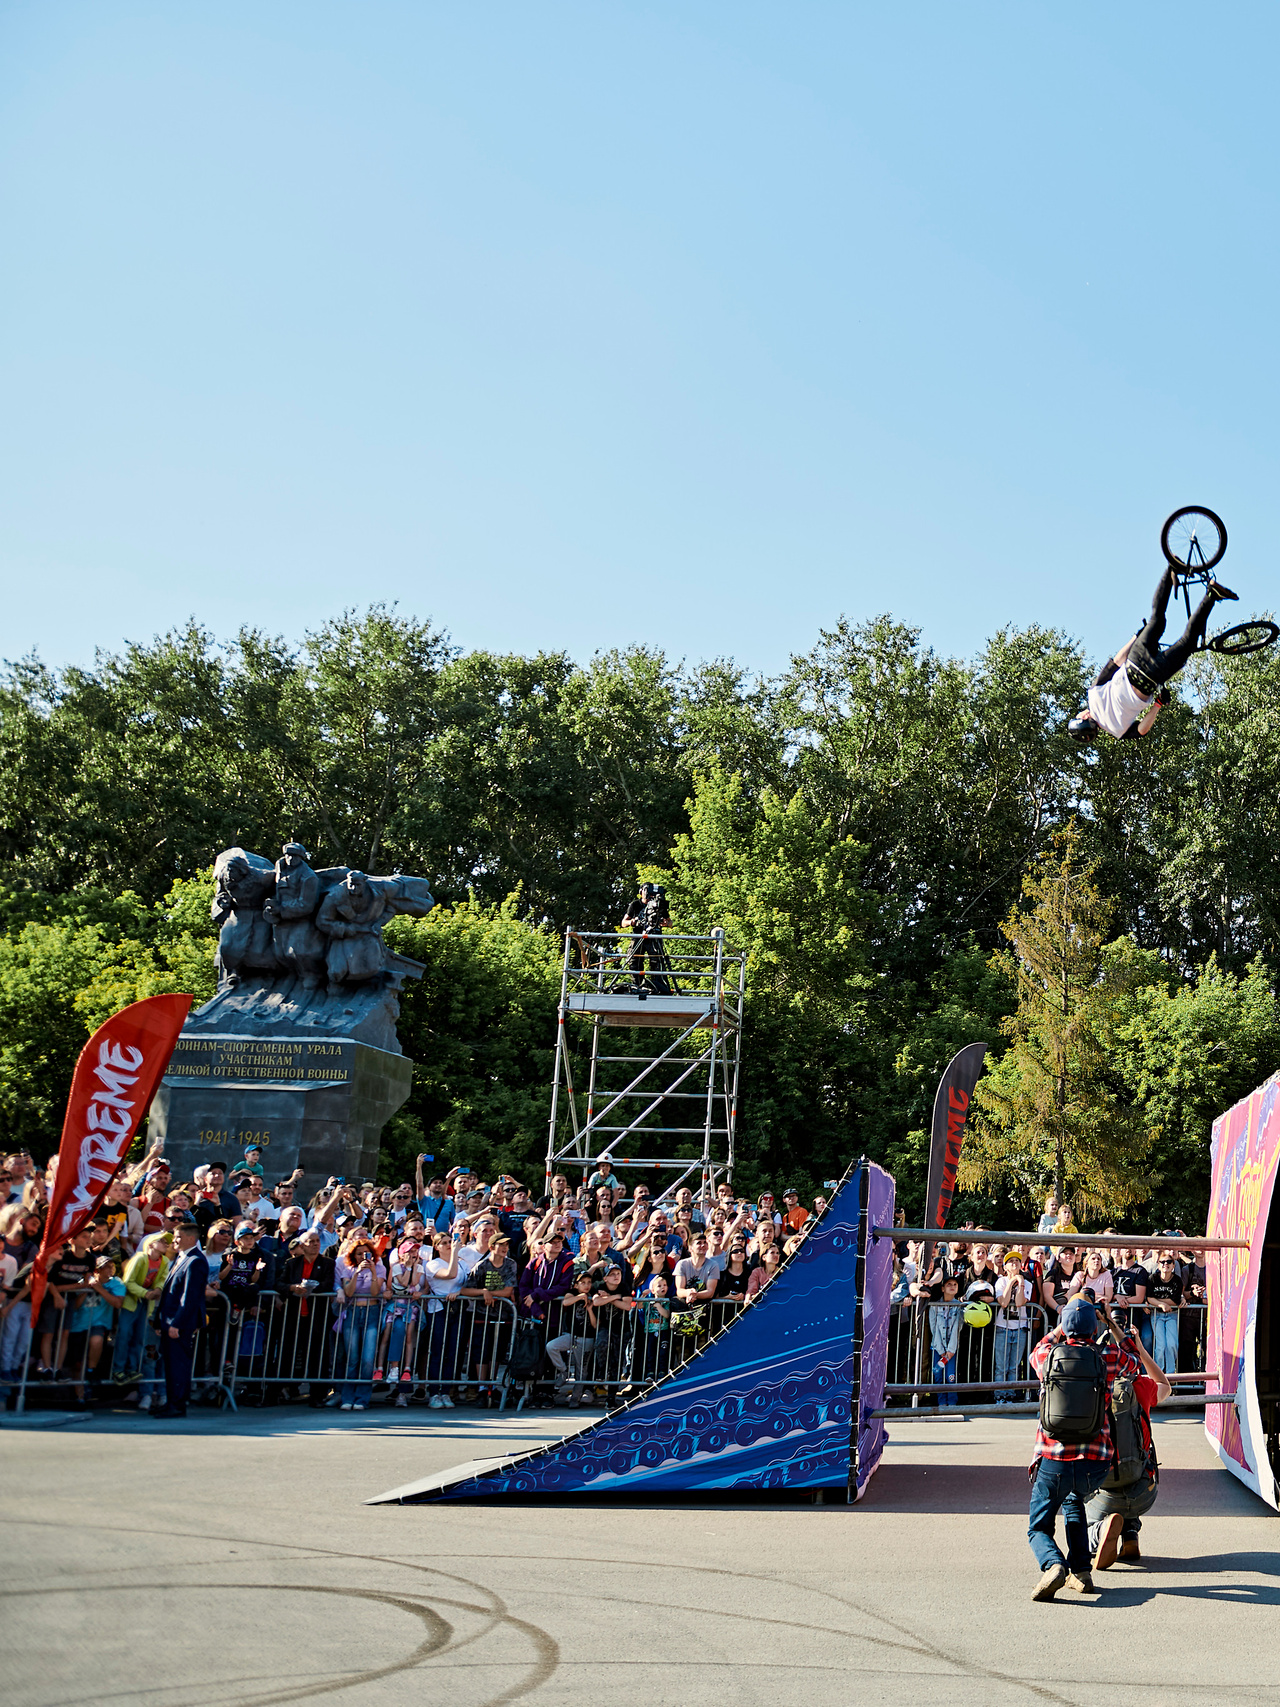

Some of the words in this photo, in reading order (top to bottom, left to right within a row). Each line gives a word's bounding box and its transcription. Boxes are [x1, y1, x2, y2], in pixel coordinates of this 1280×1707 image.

[307, 1044, 343, 1056] УРАЛА
[218, 1053, 293, 1066] УЧАСТНИКАМ
[164, 1063, 210, 1076] ЕЛИКОЙ
[213, 1066, 305, 1079] ОТЕЧЕСТВЕННОЙ
[1116, 1276, 1130, 1295] K
